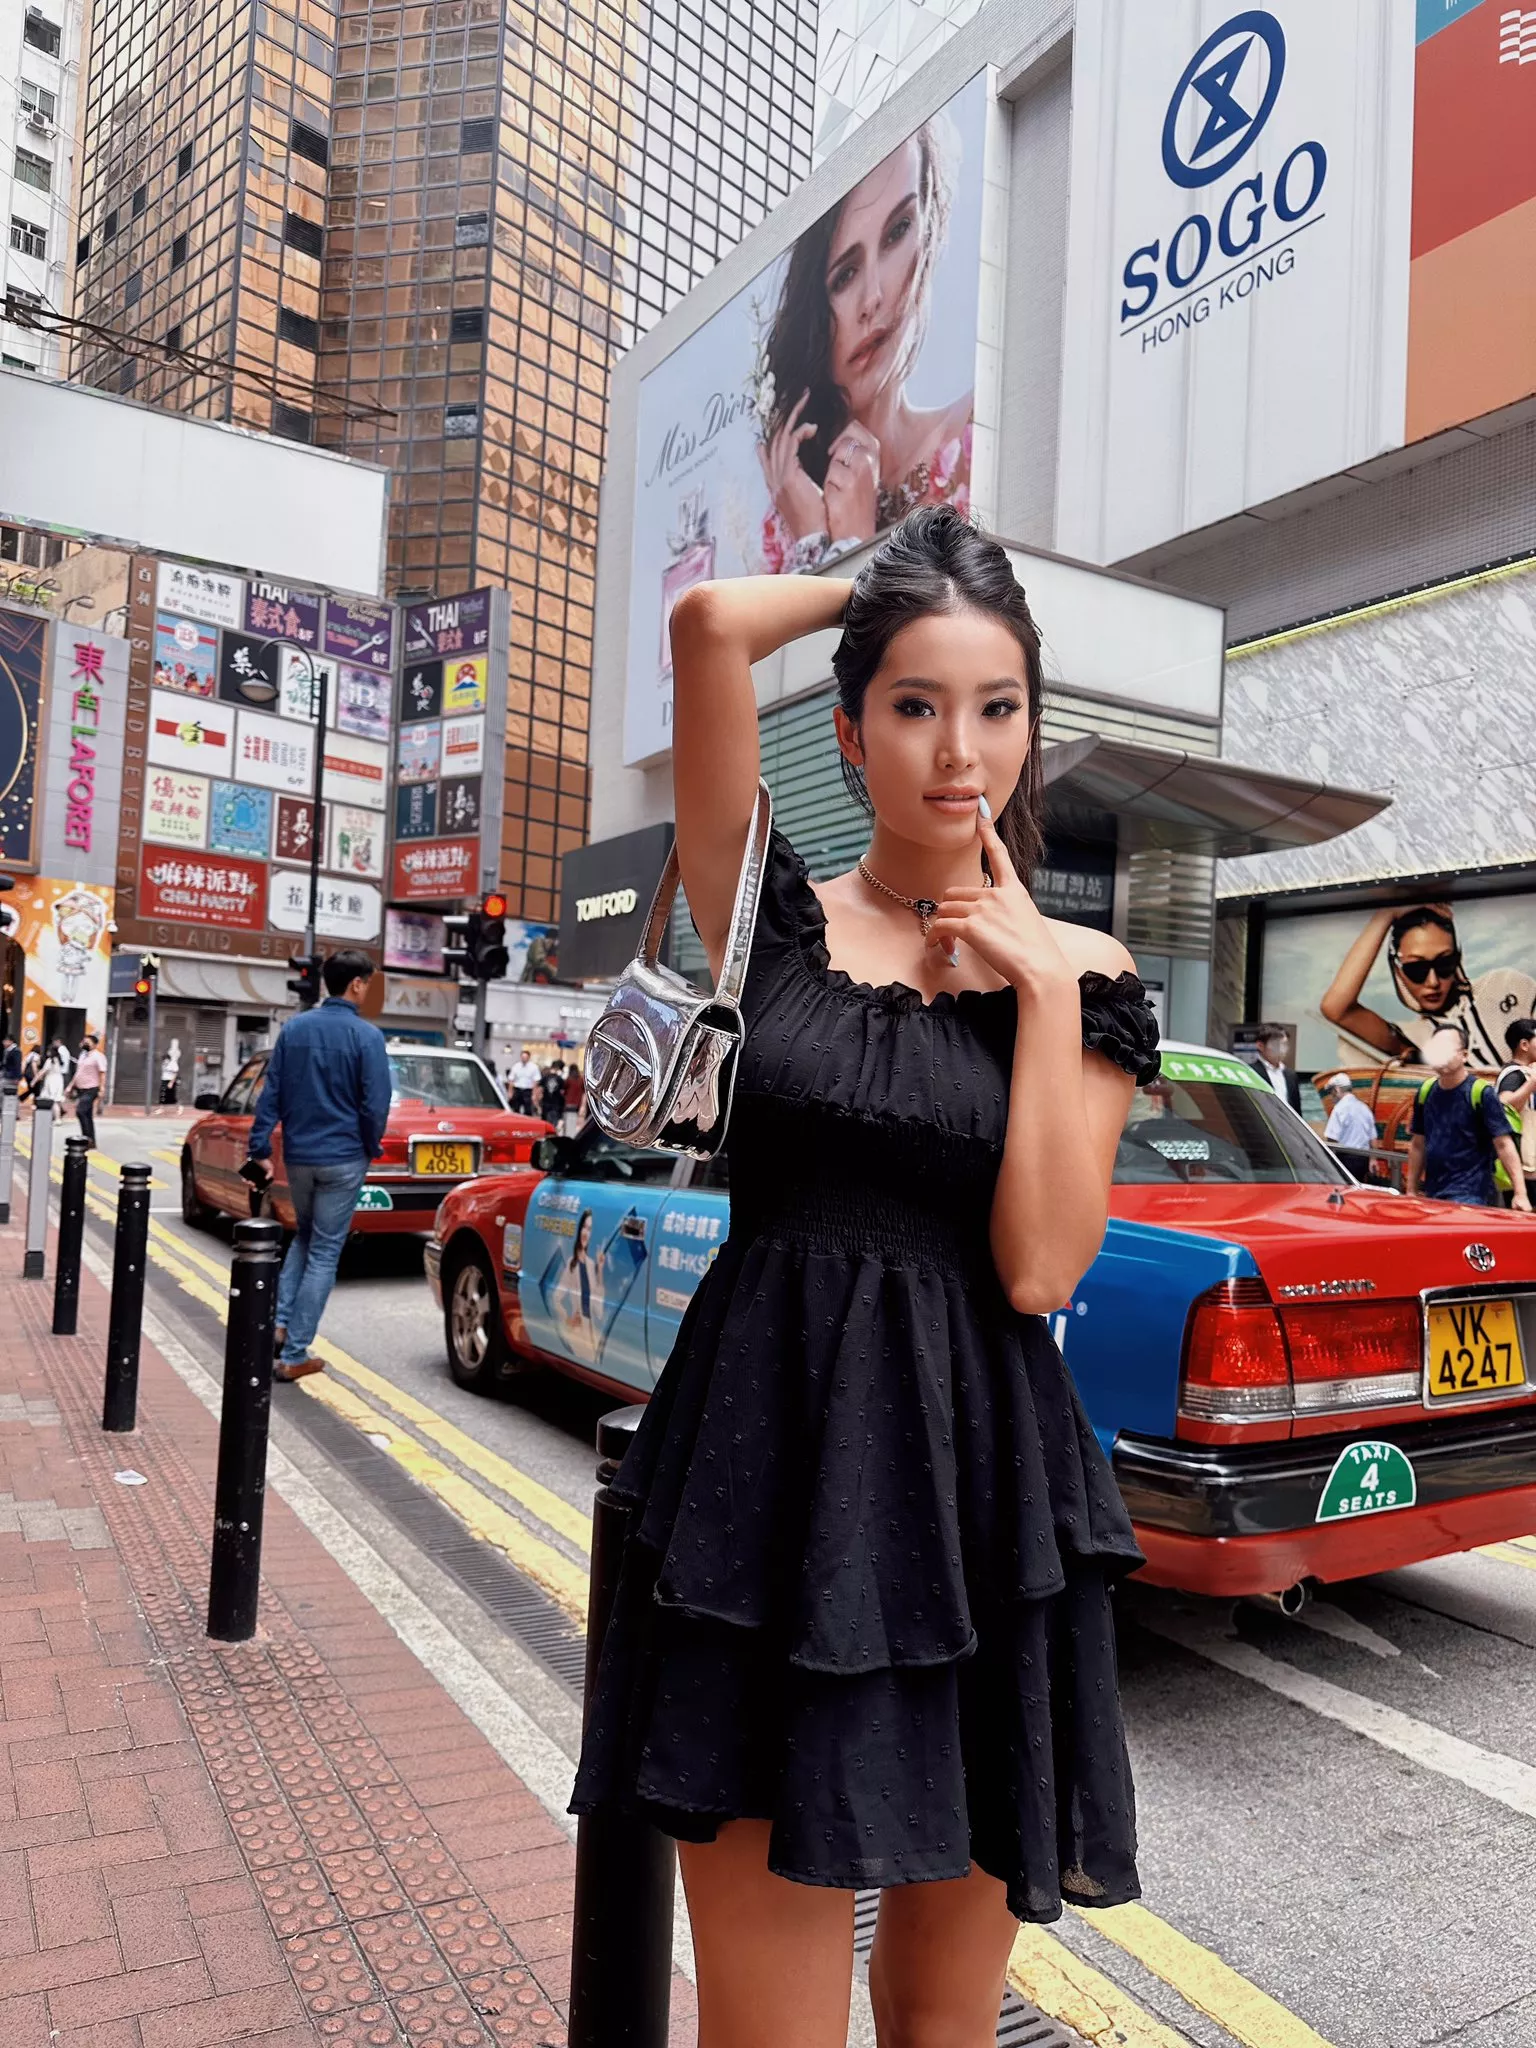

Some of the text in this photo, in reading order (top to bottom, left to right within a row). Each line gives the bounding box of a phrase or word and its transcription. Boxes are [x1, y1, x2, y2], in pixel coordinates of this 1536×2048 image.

[1121, 141, 1327, 323] SOGO
[1142, 248, 1295, 354] HONG KONG
[644, 422, 696, 487] Miss
[428, 601, 460, 632] THAI
[116, 624, 151, 902] ISLAND BEVERLEY
[65, 725, 98, 852] LAFORET
[153, 861, 249, 895] 麻辣派對
[200, 893, 247, 912] PARTY
[575, 888, 637, 922] TOM FORD
[149, 925, 231, 951] ISLAND
[425, 1158, 465, 1174] 4051
[432, 1143, 455, 1158] UG
[361, 1192, 371, 1204] 4
[1448, 1304, 1492, 1347] VK
[1438, 1343, 1512, 1390] 4247
[1349, 1444, 1391, 1464] TAXI
[1360, 1462, 1379, 1491] 4
[1338, 1490, 1397, 1513] SEATS
